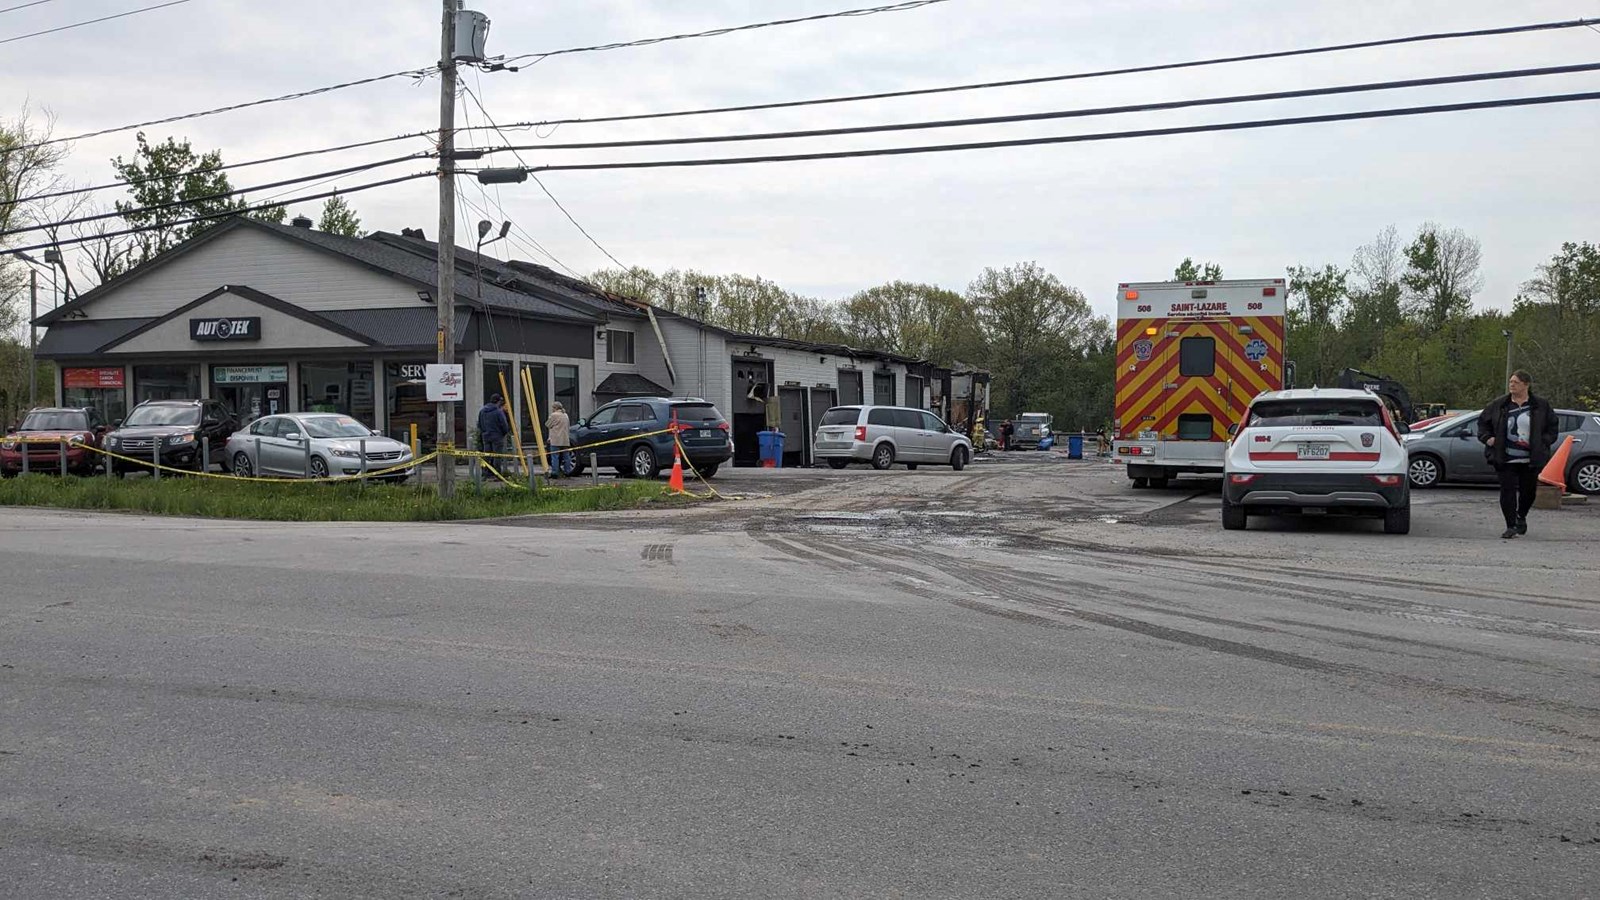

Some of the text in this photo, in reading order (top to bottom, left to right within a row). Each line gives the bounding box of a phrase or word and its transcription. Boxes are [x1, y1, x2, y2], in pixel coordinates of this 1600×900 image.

[1171, 302, 1228, 312] SAINT-LAZARE
[1247, 302, 1263, 310] 508
[1298, 447, 1329, 456] FVF6207
